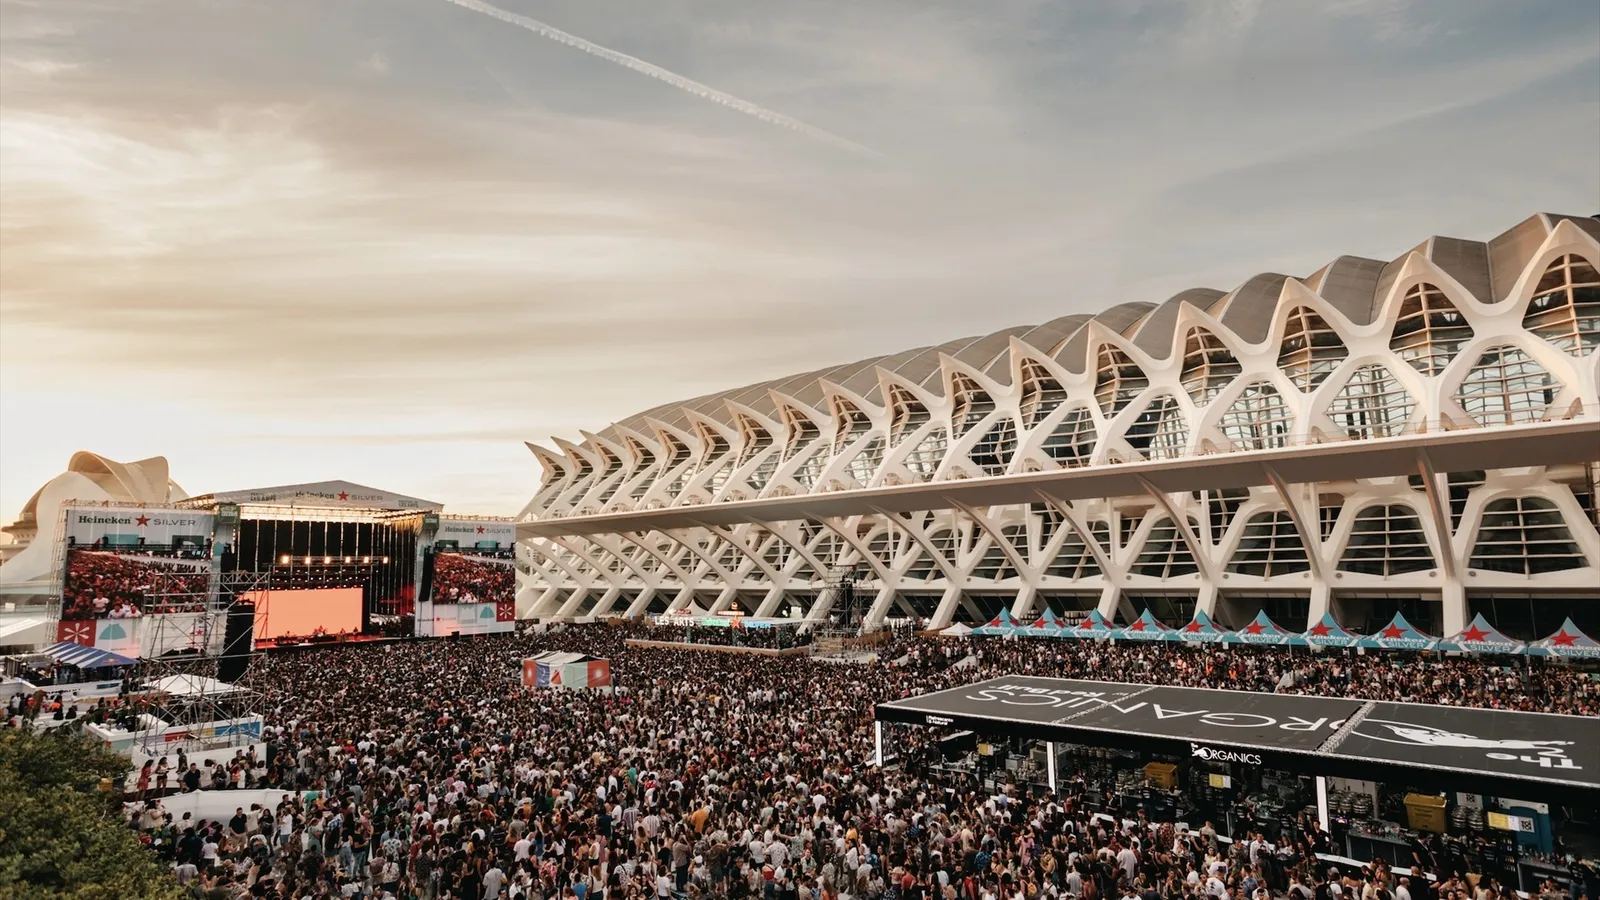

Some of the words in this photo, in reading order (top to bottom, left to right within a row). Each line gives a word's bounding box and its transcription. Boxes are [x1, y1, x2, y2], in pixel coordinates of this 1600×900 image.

[78, 515, 131, 525] Heineken
[153, 518, 196, 526] SILVER
[654, 616, 670, 625] LES
[673, 616, 695, 627] ARTS
[1559, 649, 1600, 657] SILVER
[1200, 746, 1262, 765] ORGANICS
